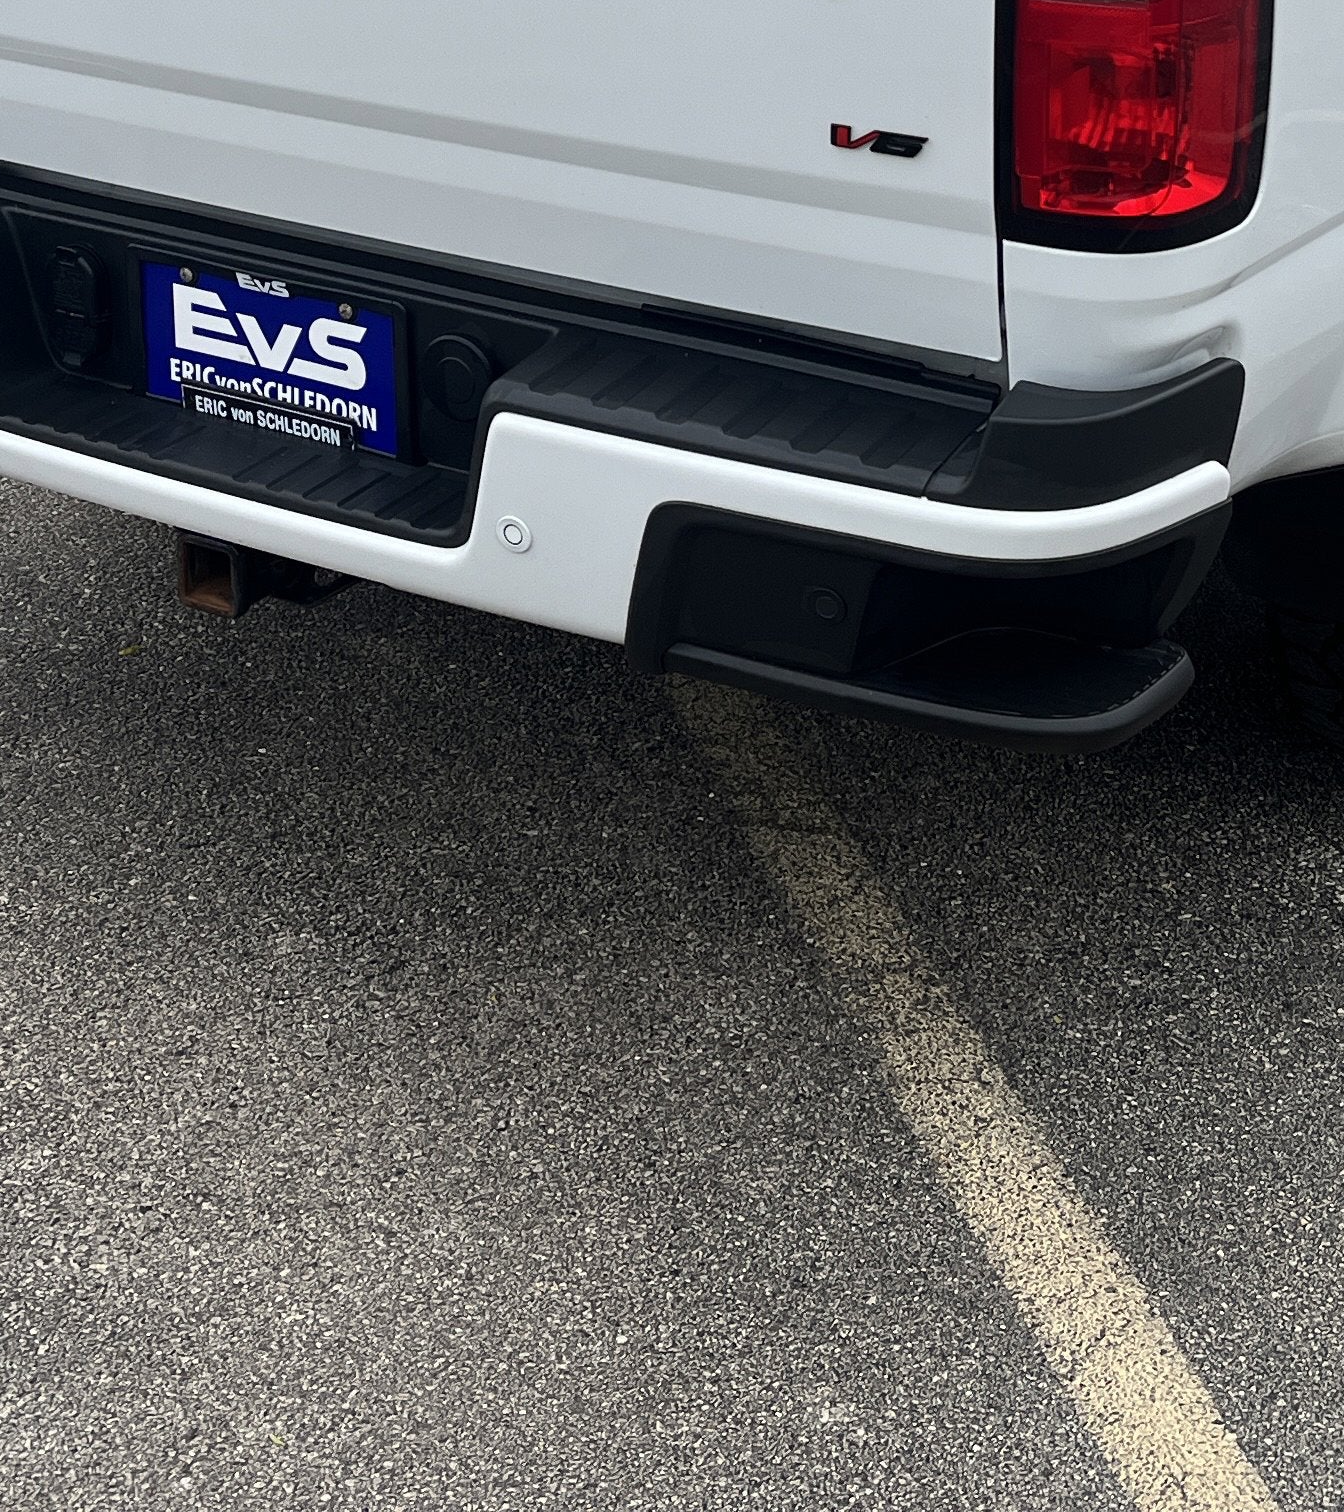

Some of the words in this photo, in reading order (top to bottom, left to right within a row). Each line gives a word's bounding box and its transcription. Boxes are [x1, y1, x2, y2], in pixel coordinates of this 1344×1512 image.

[830, 123, 929, 159] V6
[195, 395, 228, 417] ERIC
[231, 406, 254, 425] von
[256, 409, 341, 447] SCHLEDORN
